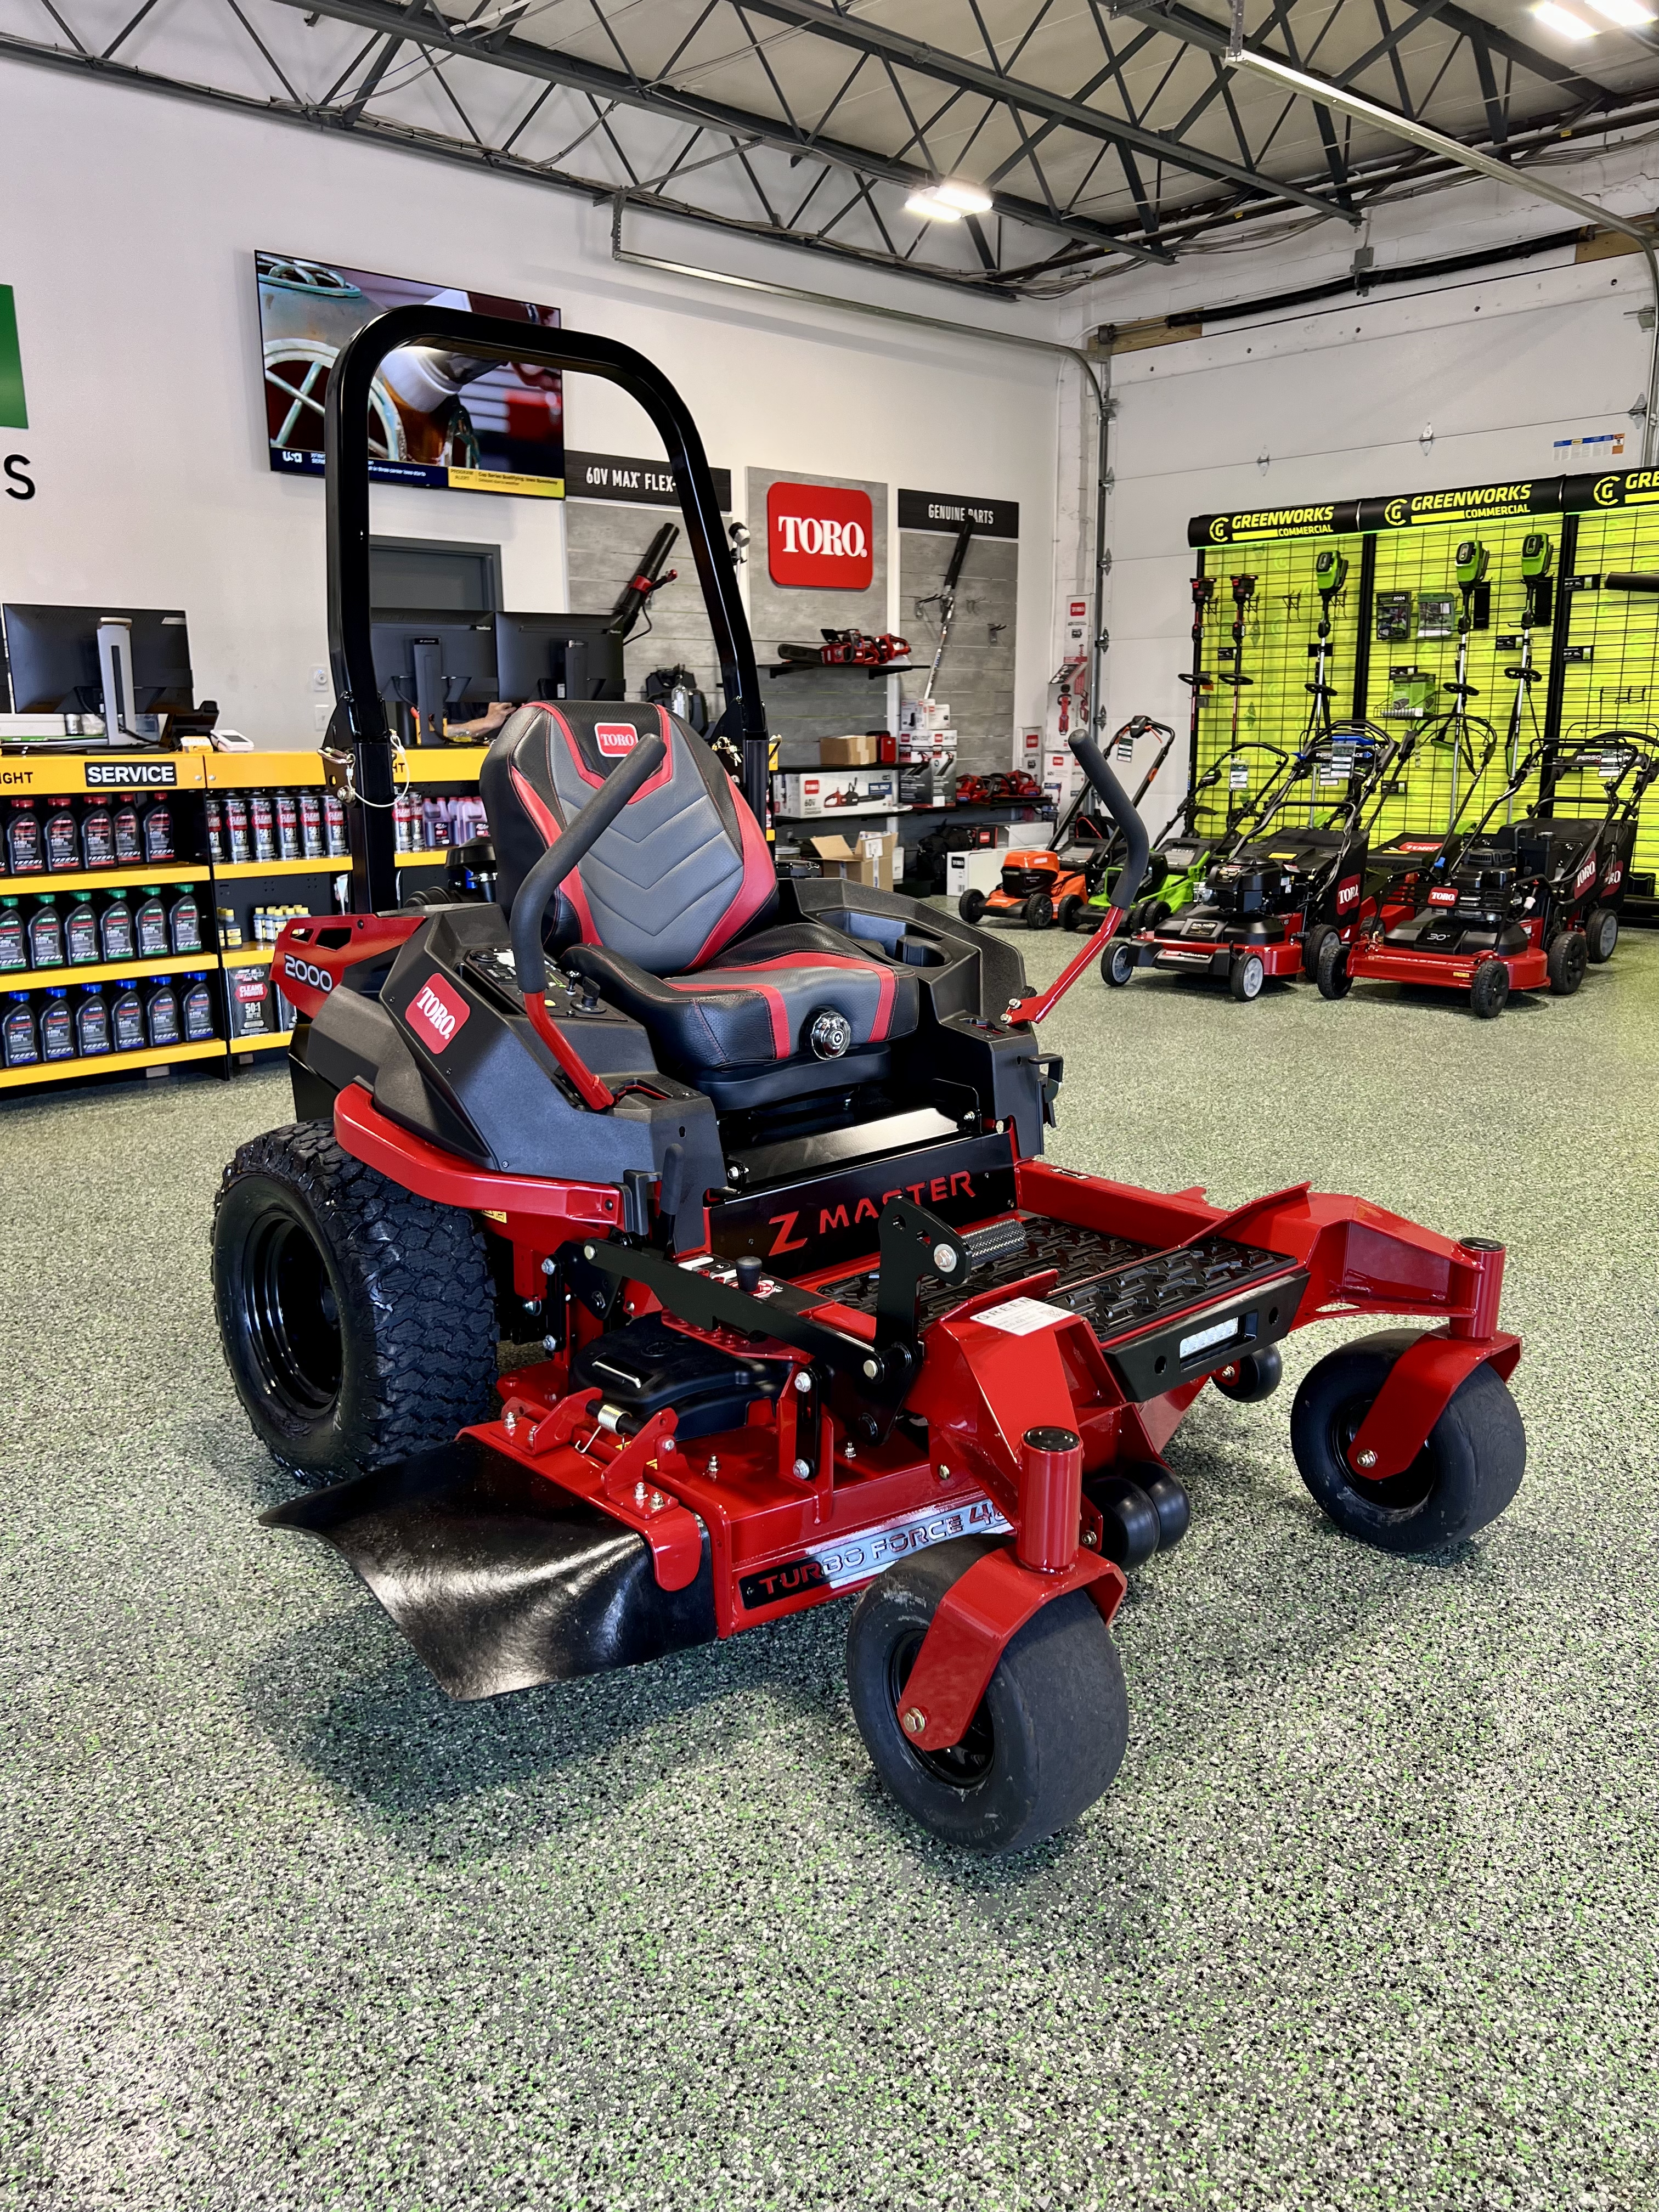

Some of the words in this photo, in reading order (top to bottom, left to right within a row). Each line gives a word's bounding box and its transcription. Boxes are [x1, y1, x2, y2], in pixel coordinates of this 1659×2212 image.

[585, 467, 608, 485] 60V
[1410, 484, 1532, 511] GREENWORKS
[928, 504, 966, 521] GENUINE
[1232, 506, 1334, 529] GREENWORKS
[1465, 504, 1531, 518] COMMERCIAL
[1278, 524, 1334, 537] COMMERCIAL
[600, 733, 635, 747] TORO
[88, 765, 175, 783] SERVICE
[1431, 891, 1455, 901] TORO
[284, 954, 333, 992] 2000
[417, 986, 457, 1040] TORO
[768, 1211, 808, 1257] Z
[976, 1297, 1032, 1321] GREEN
[758, 1547, 866, 1594] TURBO
[871, 1515, 964, 1560] FORCE
